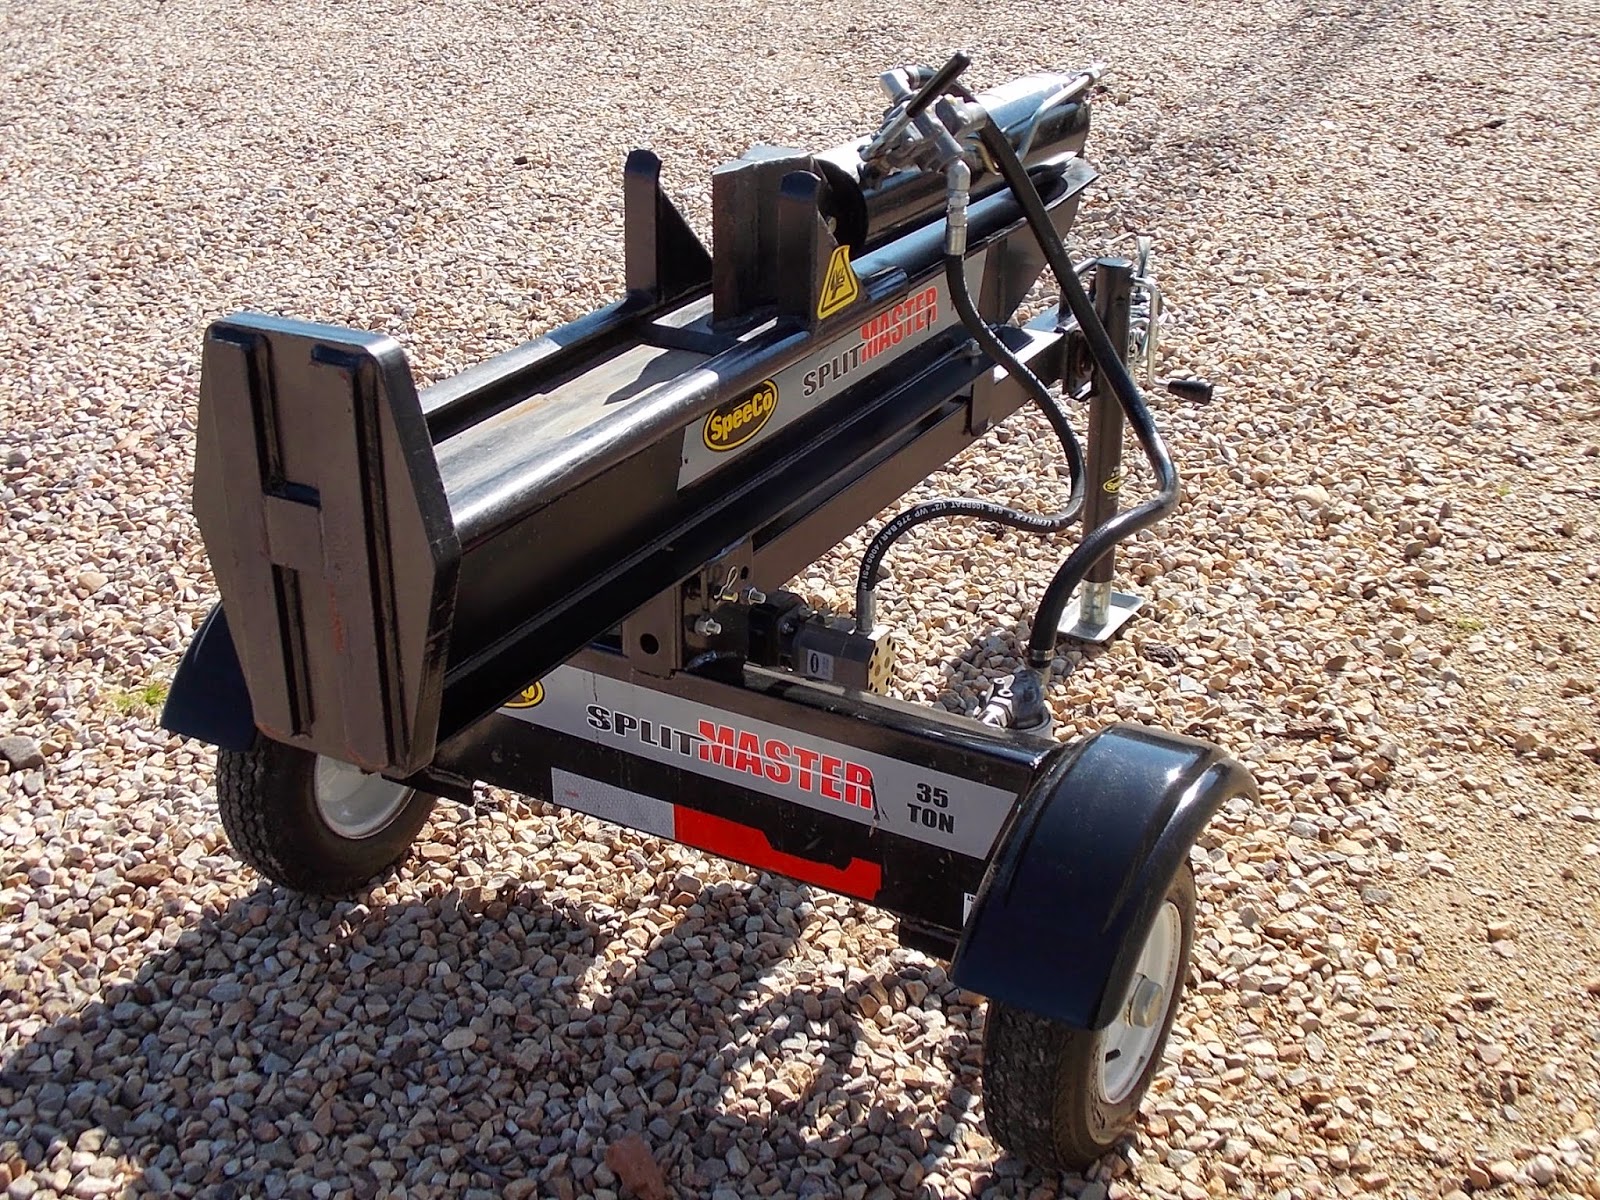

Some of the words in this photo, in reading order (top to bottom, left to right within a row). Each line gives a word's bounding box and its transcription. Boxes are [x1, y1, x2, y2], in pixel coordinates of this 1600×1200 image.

[896, 514, 912, 528] 275
[914, 507, 929, 518] WP
[880, 524, 898, 541] BAR
[866, 543, 880, 564] 4000
[861, 563, 871, 580] PSI
[916, 782, 949, 808] 35
[907, 803, 955, 835] TON
